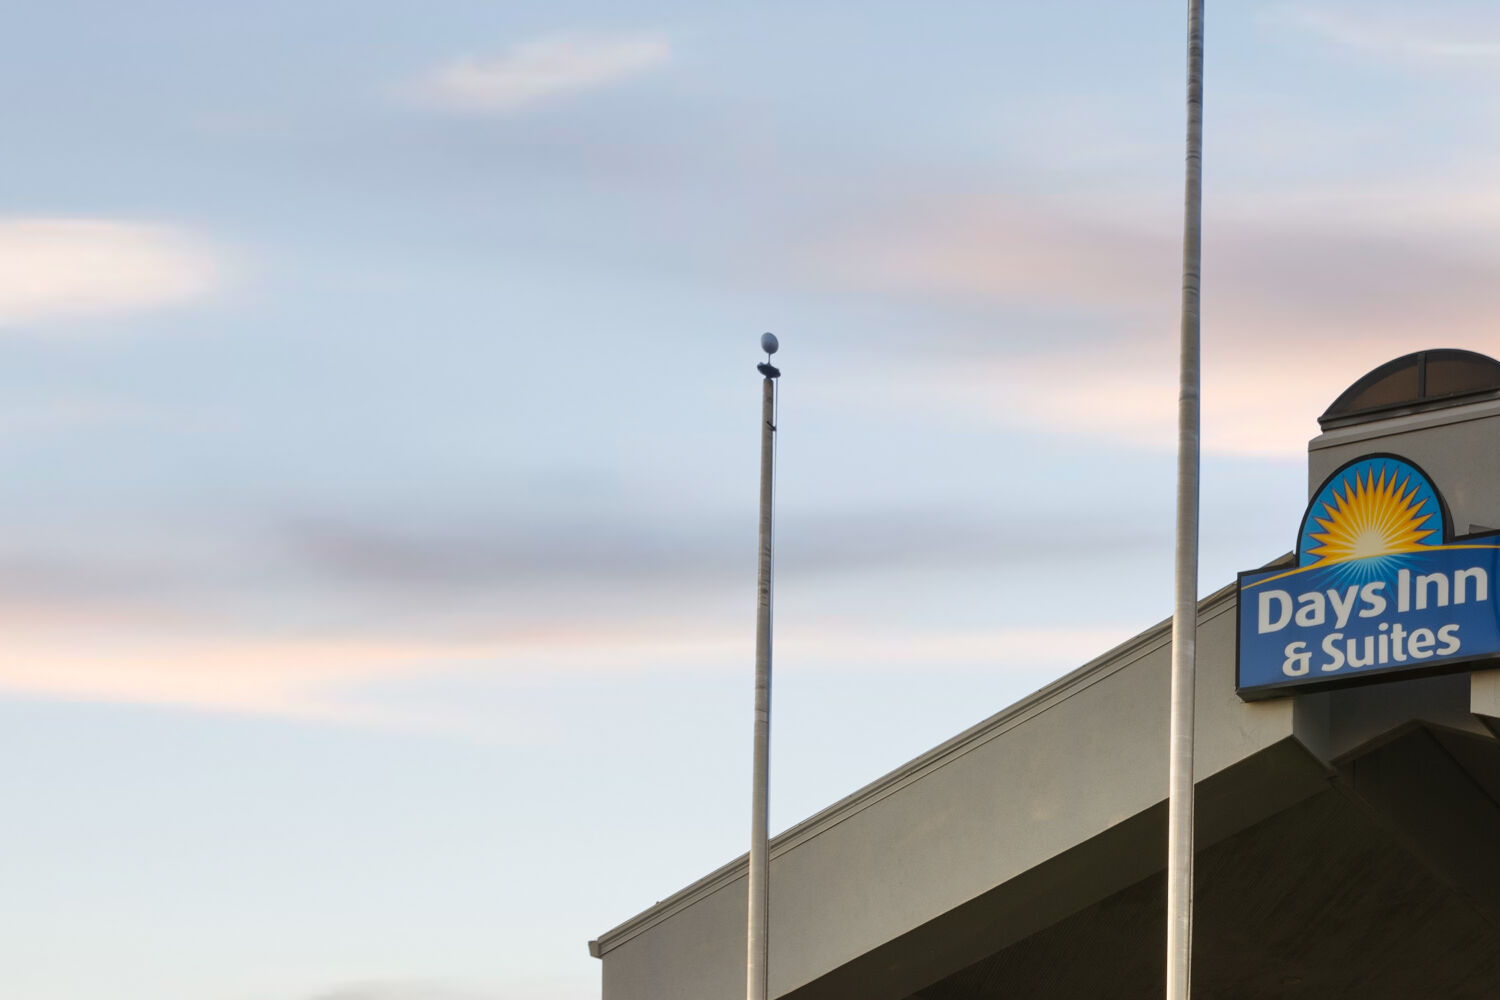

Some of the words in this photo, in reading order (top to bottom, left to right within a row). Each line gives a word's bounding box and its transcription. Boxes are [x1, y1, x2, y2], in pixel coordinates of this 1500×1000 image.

[1258, 581, 1387, 635] Days
[1398, 566, 1488, 613] Inn
[1282, 641, 1312, 677] &
[1321, 622, 1461, 672] Suites
